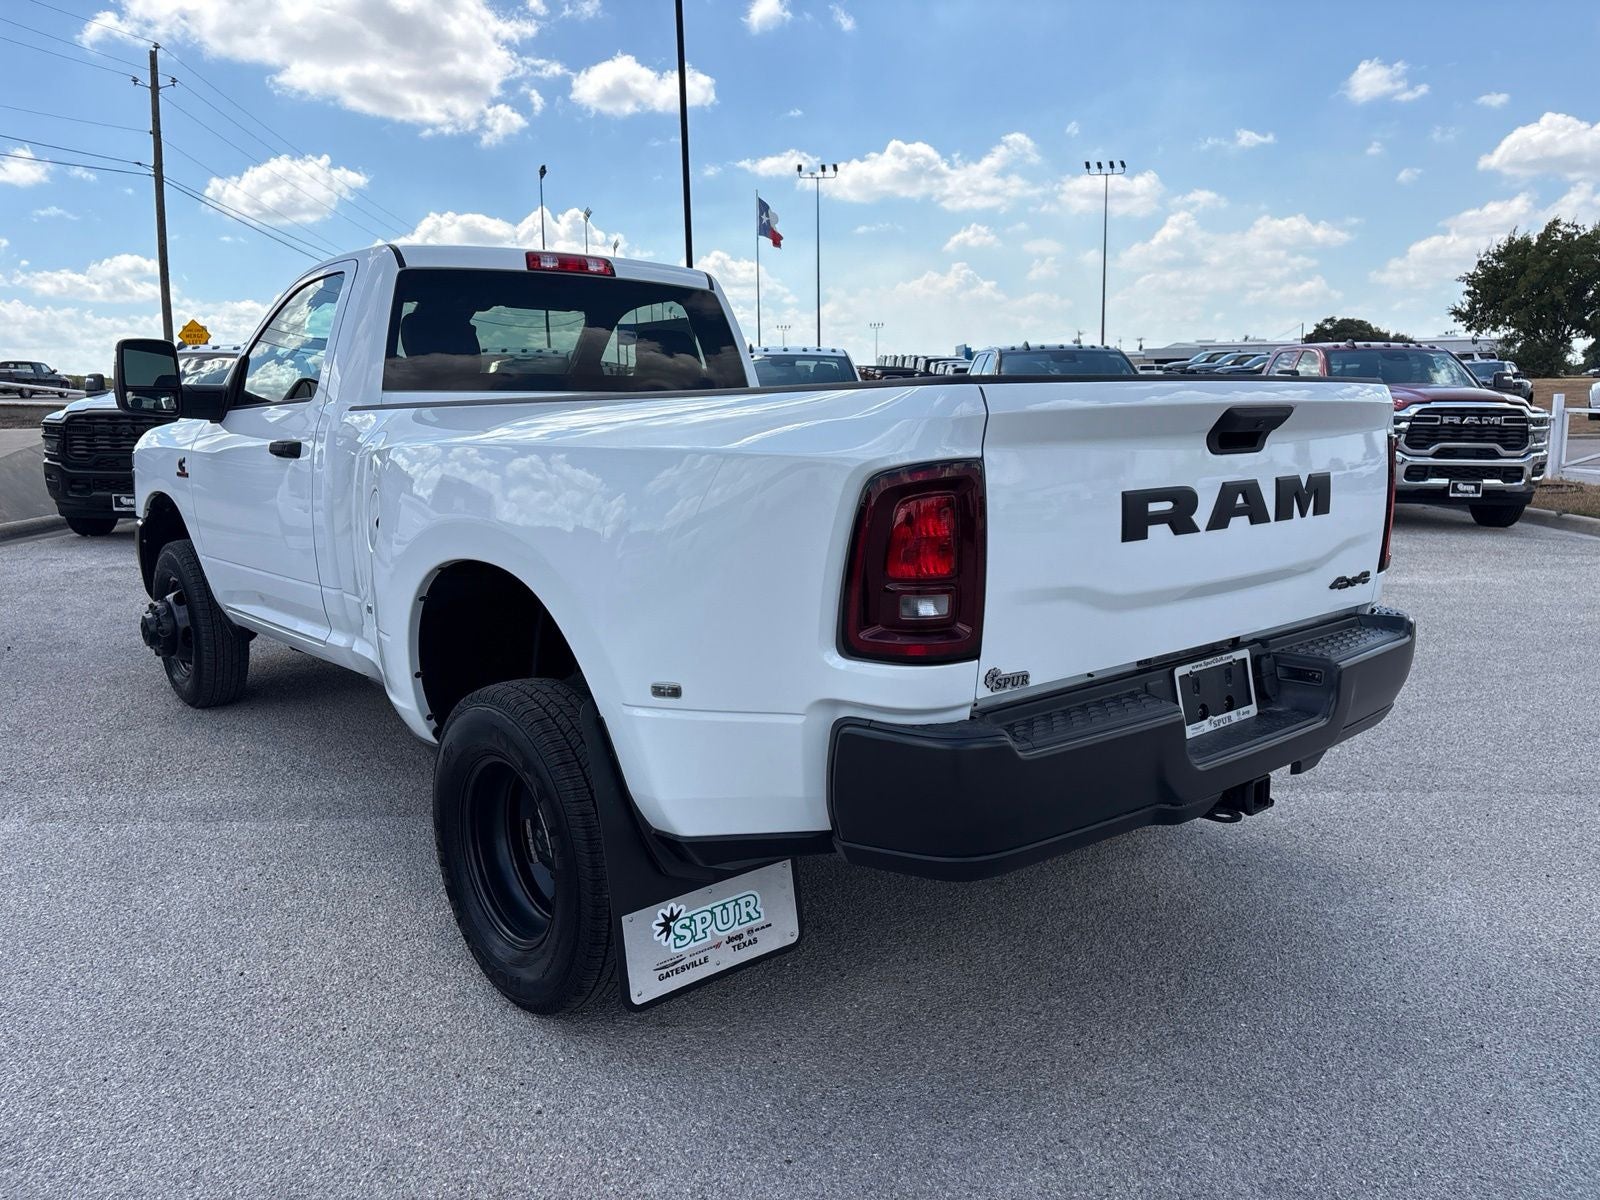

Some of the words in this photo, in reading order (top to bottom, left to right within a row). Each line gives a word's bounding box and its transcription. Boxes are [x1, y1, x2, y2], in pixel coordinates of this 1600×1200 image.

[1442, 416, 1502, 425] RAM
[1121, 471, 1331, 543] RAM
[994, 674, 1029, 690] SPUR
[1212, 715, 1233, 728] SPUR
[672, 893, 761, 949] SPUR
[725, 932, 744, 945] Jeep
[754, 922, 772, 933] RAM
[658, 956, 709, 982] GATESVILLE
[731, 937, 758, 952] TEXAS
